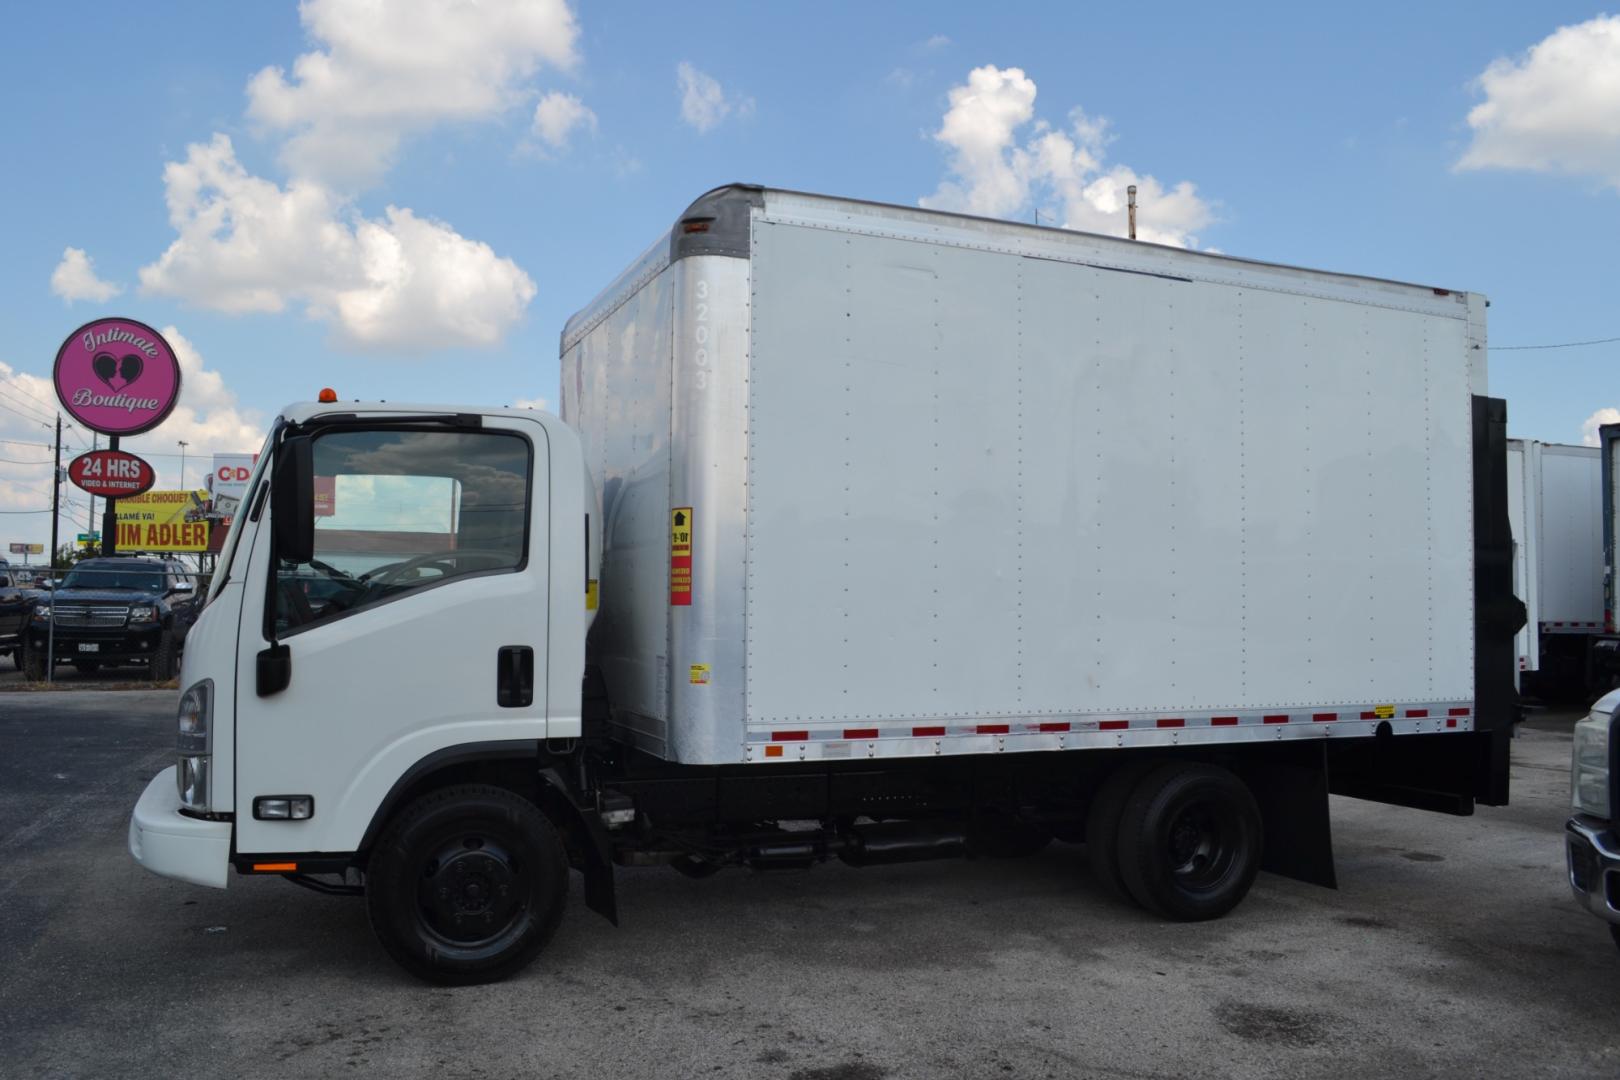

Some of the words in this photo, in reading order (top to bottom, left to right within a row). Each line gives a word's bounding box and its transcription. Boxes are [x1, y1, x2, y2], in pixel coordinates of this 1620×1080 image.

[83, 328, 159, 359] Intimate
[695, 280, 709, 390] 32003
[72, 387, 160, 413] Boutique
[81, 457, 101, 477] 24
[106, 458, 141, 479] HRS
[81, 479, 101, 488] VIDEO
[108, 481, 140, 489] INTERNET
[145, 523, 206, 546] ADLER
